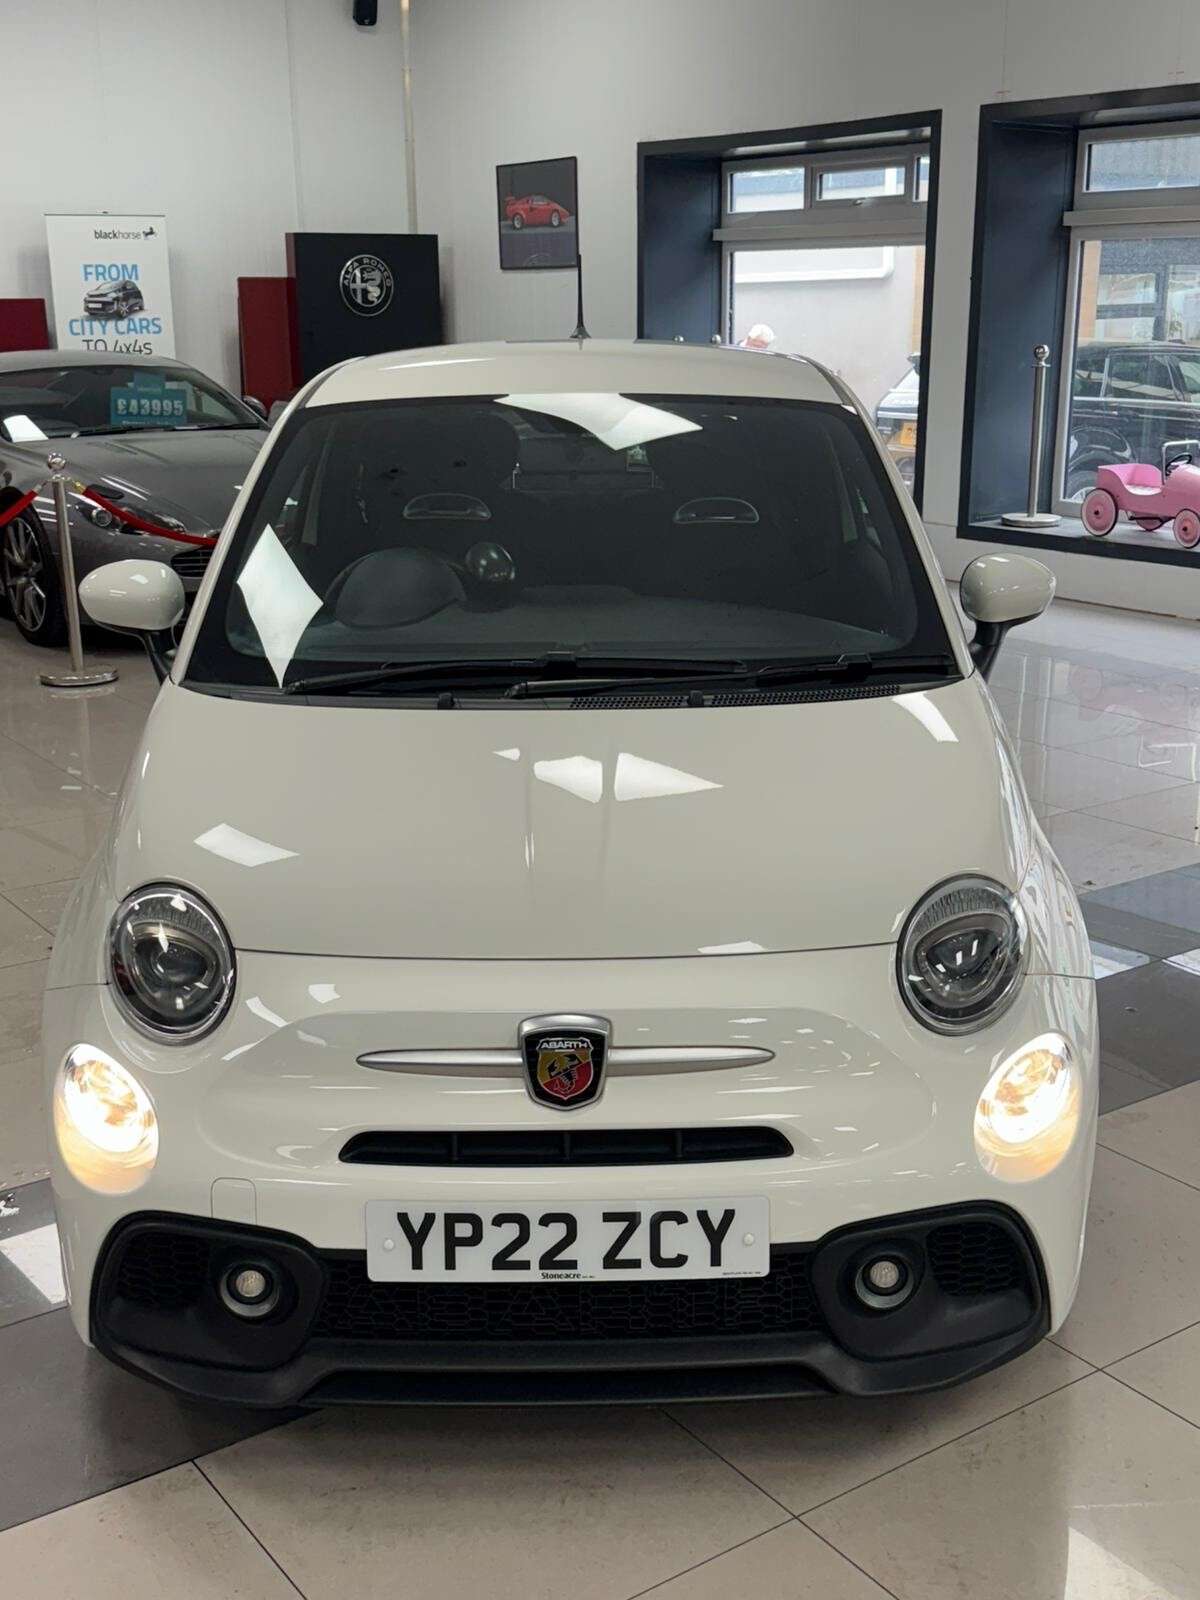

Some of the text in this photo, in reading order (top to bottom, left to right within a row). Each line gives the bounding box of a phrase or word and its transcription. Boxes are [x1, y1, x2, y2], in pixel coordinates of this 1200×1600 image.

[94, 229, 141, 240] blackhorse
[83, 264, 139, 281] FROM
[68, 317, 162, 336] CITY CARS
[82, 339, 108, 352] TO
[117, 399, 183, 416] £43995
[541, 1041, 588, 1049] ABARTH
[396, 1208, 736, 1271] YP22 ZCY
[541, 1271, 582, 1280] Stoneacre
